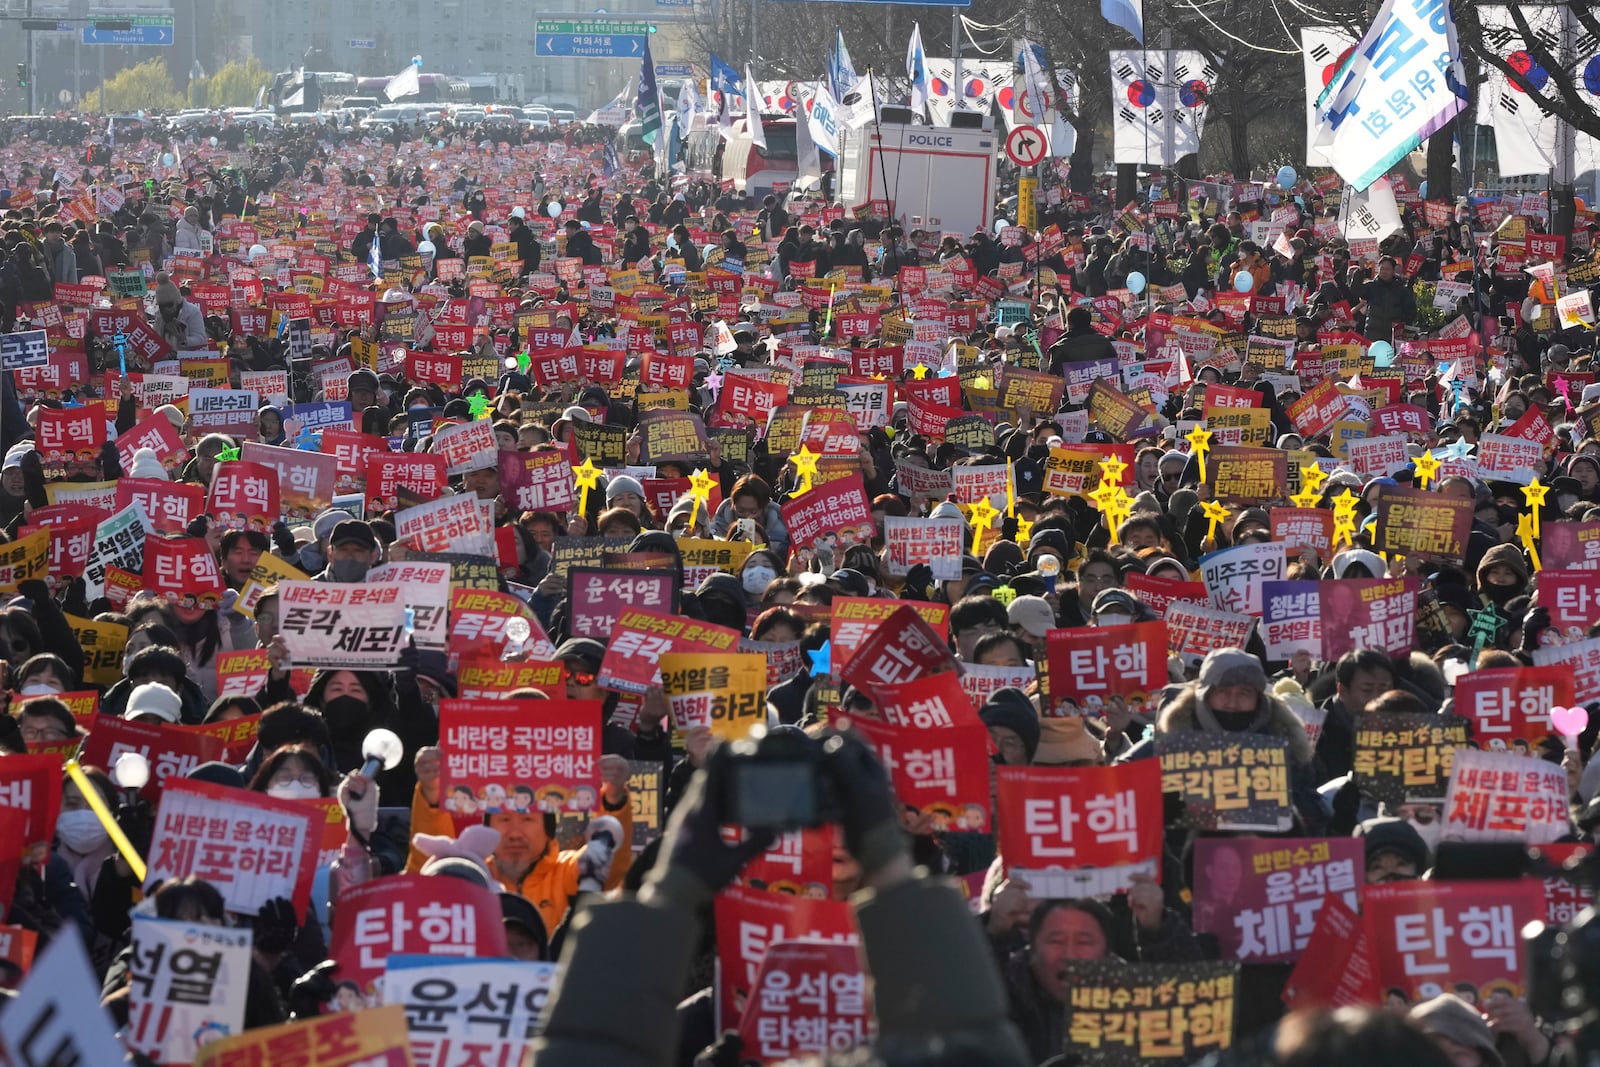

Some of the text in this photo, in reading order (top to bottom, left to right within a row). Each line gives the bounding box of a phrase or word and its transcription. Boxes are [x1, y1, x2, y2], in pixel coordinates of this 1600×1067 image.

[573, 37, 612, 46] 여의서로
[813, 102, 836, 136] 해남
[909, 135, 952, 147] POLICE
[1355, 205, 1381, 235] 독립군
[1531, 240, 1556, 255] 탄핵
[713, 280, 734, 293] 탄핵
[342, 310, 370, 324] 탄핵
[442, 305, 466, 321] 탄핵
[1095, 300, 1118, 312] 탄핵
[1255, 300, 1280, 314] 탄핵
[98, 309, 131, 331] 탄핵
[240, 315, 266, 332] 탄핵
[842, 320, 869, 333] 탄핵
[945, 315, 970, 329] 탄핵
[128, 327, 161, 359] 탄핵
[437, 332, 465, 347] 탄핵
[535, 333, 564, 348] 탄핵
[629, 334, 655, 350] 탄핵
[672, 329, 698, 342] 탄핵
[1, 336, 47, 368] 군포
[414, 360, 452, 381] 탄핵
[540, 355, 578, 380] 탄핵
[584, 358, 616, 378] 탄핵
[648, 360, 686, 384] 탄핵
[858, 354, 894, 376] 탄핵
[1068, 361, 1113, 382] 청년명령
[1323, 358, 1360, 374] 탄핵하라
[20, 368, 60, 392] 탄핵
[264, 374, 284, 386] 윤석열
[1008, 379, 1053, 397] 윤석열을
[195, 394, 252, 412] 내란수괴
[732, 386, 774, 412] 탄핵
[914, 386, 950, 407] 탄핵
[192, 411, 254, 426] 윤석열 탄핵!
[1208, 414, 1250, 429] 윤석열을
[1296, 393, 1344, 430] 즉각 탄핵!
[1381, 409, 1420, 430] 탄핵
[40, 416, 94, 447] 탄핵
[435, 422, 490, 454] 내란범 윤석열
[648, 420, 694, 442] 윤석열을
[1219, 426, 1272, 445] 탄핵하라
[648, 440, 699, 459] 탄핵하라
[824, 434, 860, 453] 탄핵
[1351, 440, 1403, 455] 내란범 윤석열
[1482, 442, 1539, 456] 내란범 윤석열
[381, 463, 436, 480] 윤석열을
[524, 451, 562, 470] 반란수괴
[531, 460, 570, 482] 윤석열
[1047, 456, 1093, 472] 윤석열을
[1217, 459, 1274, 480] 윤석열을
[1352, 450, 1406, 474] 체포하라
[1478, 452, 1539, 471] 체포하라
[214, 474, 269, 512] 탄핵
[381, 480, 438, 496] 탄핵하라
[516, 478, 574, 511] 체포!
[900, 475, 950, 492] 체포하라
[1214, 479, 1270, 498] 탄핵하라
[131, 490, 190, 528] 탄핵
[400, 499, 474, 536] 내란범 윤석열
[788, 489, 863, 529] 내란수괴 윤석열
[1388, 504, 1456, 528] 윤석열을
[792, 508, 867, 544] 법대로 처단하라
[889, 526, 960, 540] 내란범 윤석열
[1384, 526, 1453, 552] 탄핵하라
[556, 547, 593, 560] 내란수괴
[679, 549, 731, 565] 윤석열을
[890, 541, 960, 569] 체포하라
[155, 552, 218, 588] 탄핵
[402, 568, 444, 584] 윤석열
[1206, 557, 1283, 591] 민주주의
[284, 587, 399, 604] 내란수괴 윤석열
[586, 577, 661, 605] 윤석열
[1213, 584, 1252, 612] 사수!
[1360, 580, 1404, 602] 반란수괴
[456, 591, 518, 614] 내란수괴
[835, 602, 900, 620] 내란수괴
[1370, 590, 1414, 620] 윤석열
[284, 607, 341, 634] 즉각
[452, 613, 506, 640] 즉각
[575, 613, 615, 635] 즉각
[619, 611, 735, 650] 내란수괴 윤석열
[1168, 612, 1248, 634] 내란범 윤석열
[334, 624, 403, 653] 체포!
[1268, 620, 1310, 645] 윤석열
[1350, 616, 1414, 653] 체포!
[610, 633, 674, 667] 즉각
[871, 622, 943, 686] 탄핵
[461, 667, 561, 685] 내란수괴 윤석열
[1070, 643, 1148, 691] 탄핵
[662, 666, 729, 691] 윤석열을
[964, 677, 1007, 692] 내란범
[672, 691, 767, 728] 탄핵하라
[1475, 686, 1554, 735] 탄핵
[447, 726, 594, 751] 내란당 국민의힘
[1355, 724, 1467, 748] 내란수괴 윤석열
[447, 754, 594, 779] 법대로 정당해산
[1161, 746, 1286, 771] 내란수괴 윤석열
[1457, 767, 1567, 794] 내란범 윤석열
[1449, 791, 1569, 832] 체포하라
[165, 814, 298, 848] 내란범 윤석열
[1023, 789, 1140, 857] 탄핵
[156, 837, 295, 883] 체포하라
[1253, 842, 1330, 874] 반란수괴
[1266, 858, 1355, 905] 윤석열
[354, 899, 477, 969] 탄핵
[1395, 904, 1518, 976] 탄핵
[761, 968, 865, 1017] 윤석열
[1071, 975, 1234, 1009] 내란수괴 윤석열
